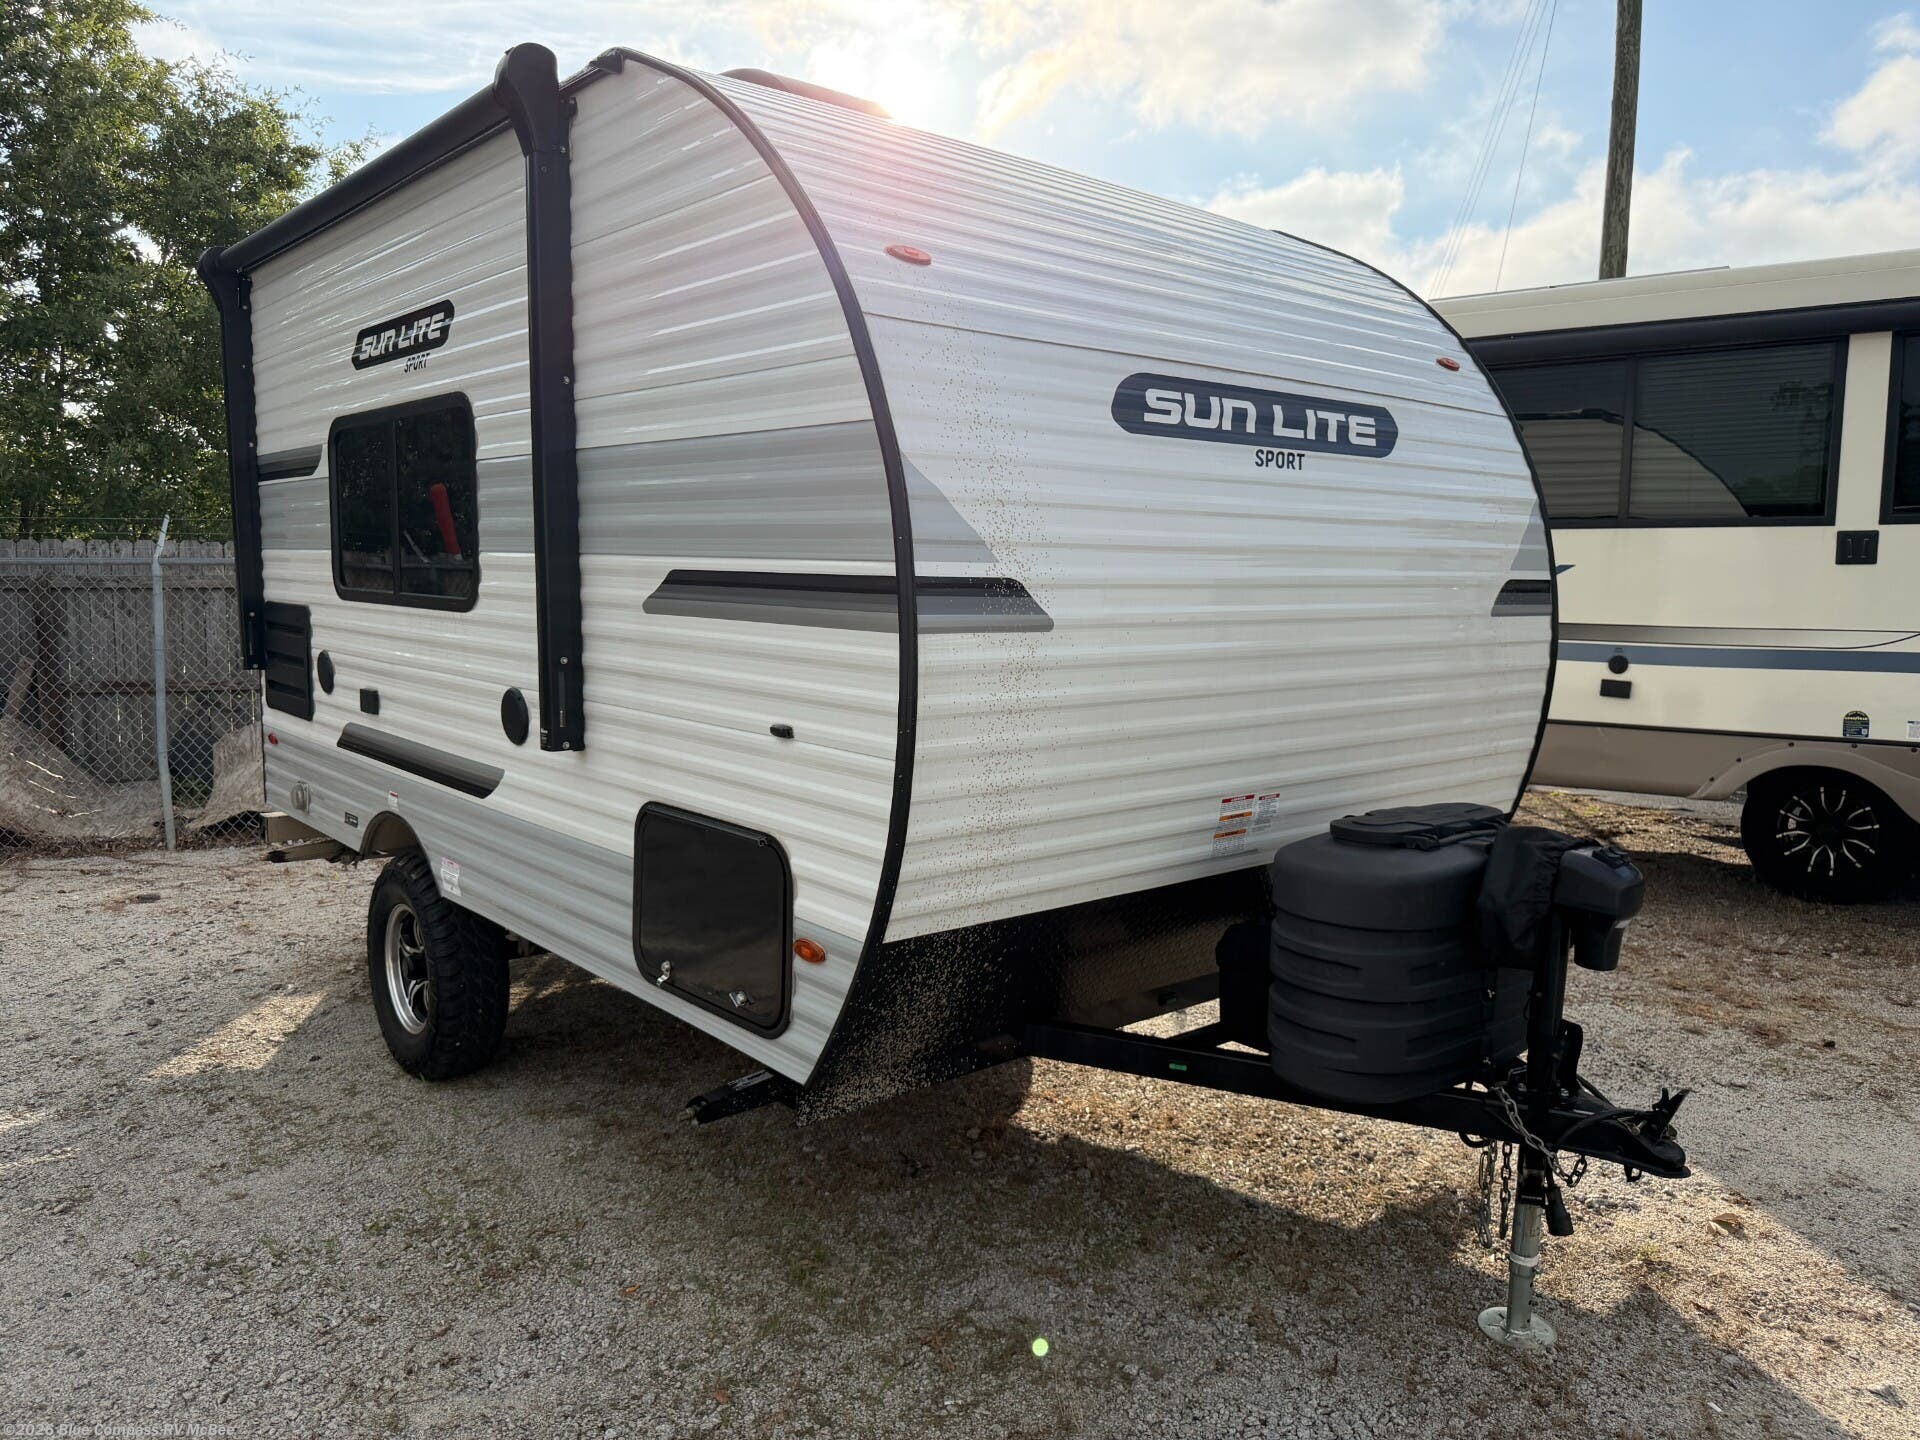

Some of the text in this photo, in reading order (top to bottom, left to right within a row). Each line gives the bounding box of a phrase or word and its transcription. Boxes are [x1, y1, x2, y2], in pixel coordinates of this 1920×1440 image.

[359, 312, 445, 361] SUN LITE
[404, 353, 431, 373] SPORT
[1143, 387, 1377, 447] SUN LITE
[1254, 448, 1306, 471] SPORT
